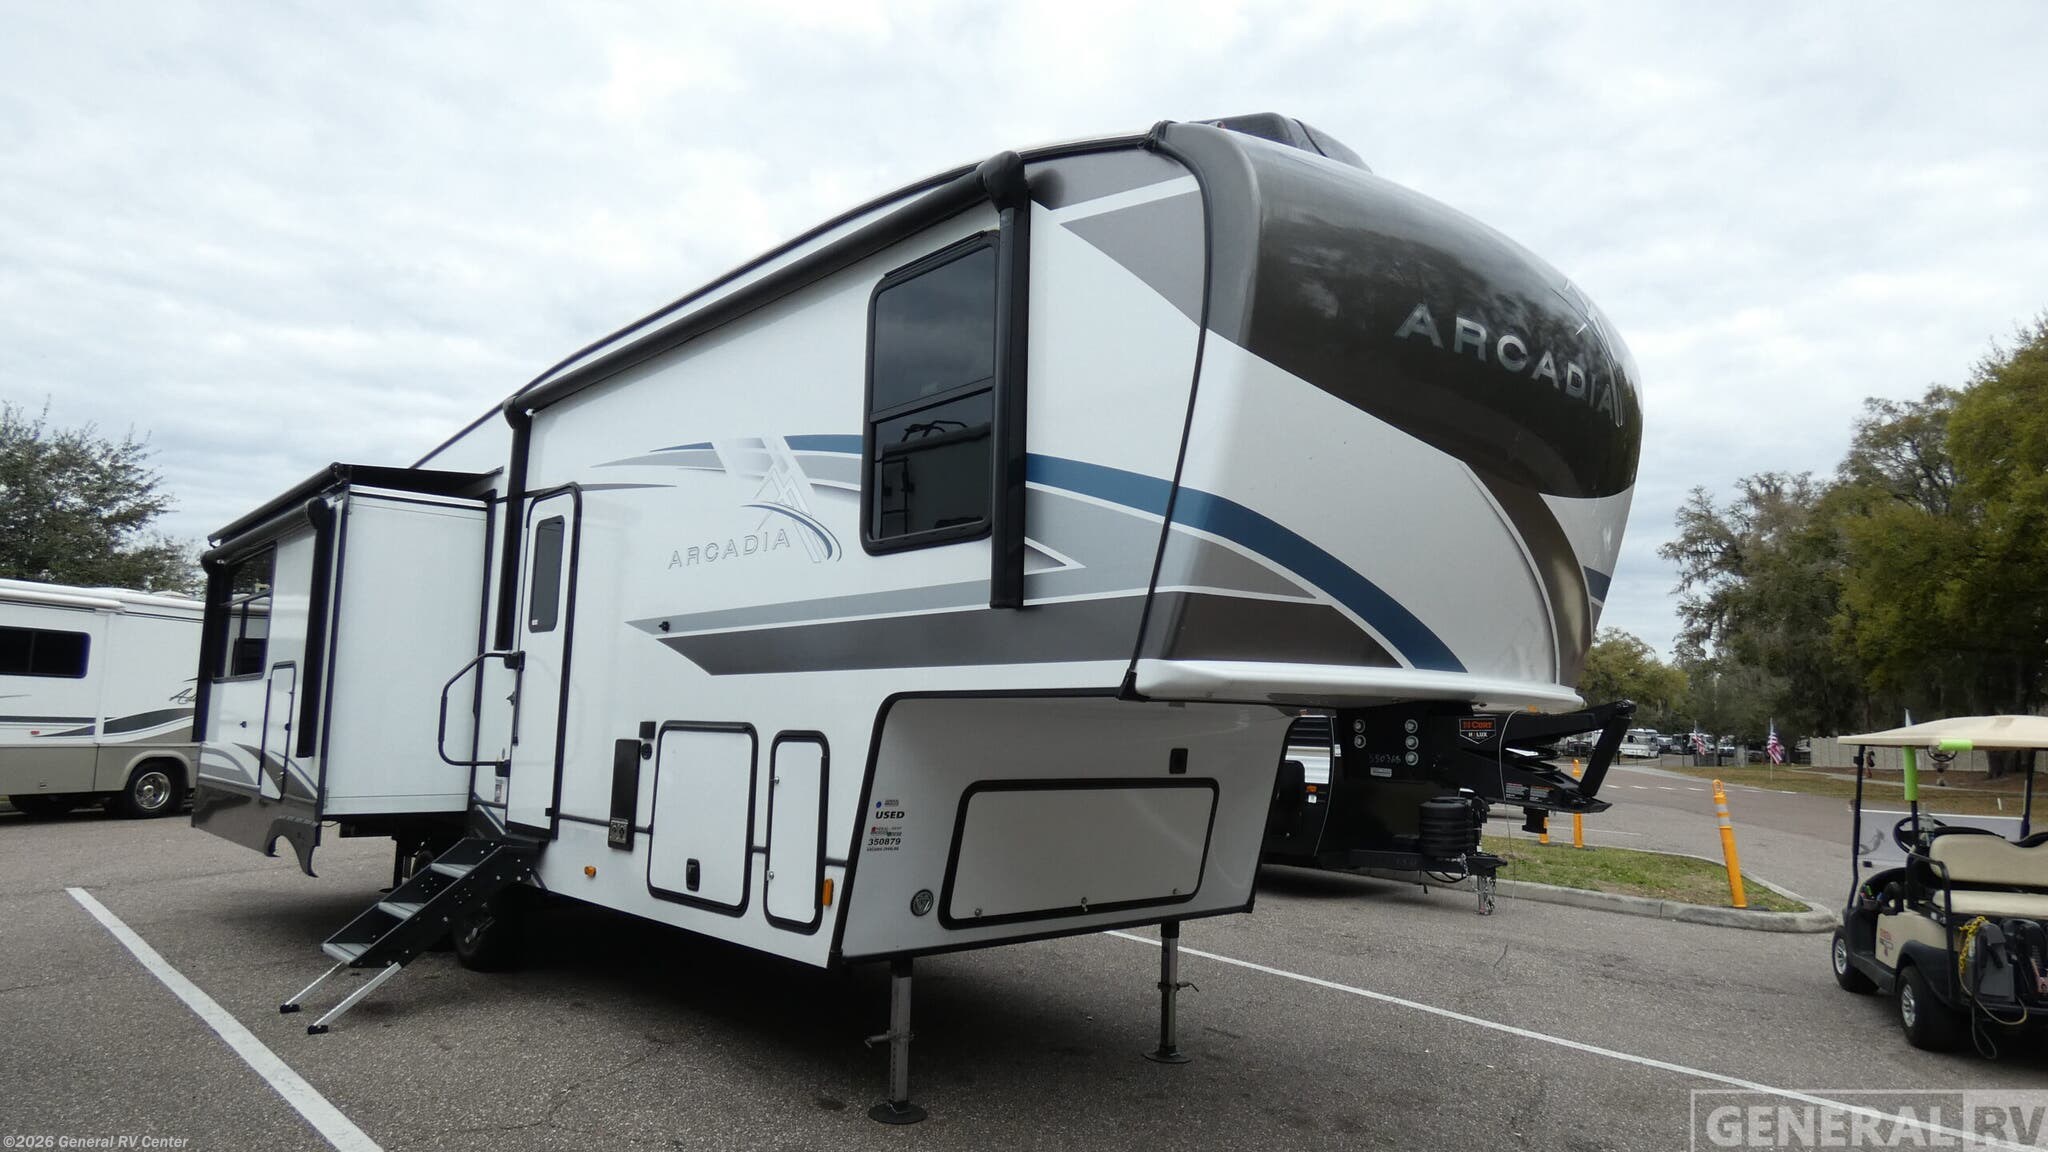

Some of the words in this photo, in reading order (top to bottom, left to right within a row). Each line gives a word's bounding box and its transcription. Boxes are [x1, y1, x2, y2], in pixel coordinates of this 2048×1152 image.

[1394, 302, 1615, 420] ARCADIA
[667, 528, 790, 570] ARCADIA
[875, 811, 905, 820] USED
[868, 838, 901, 846] 350879
